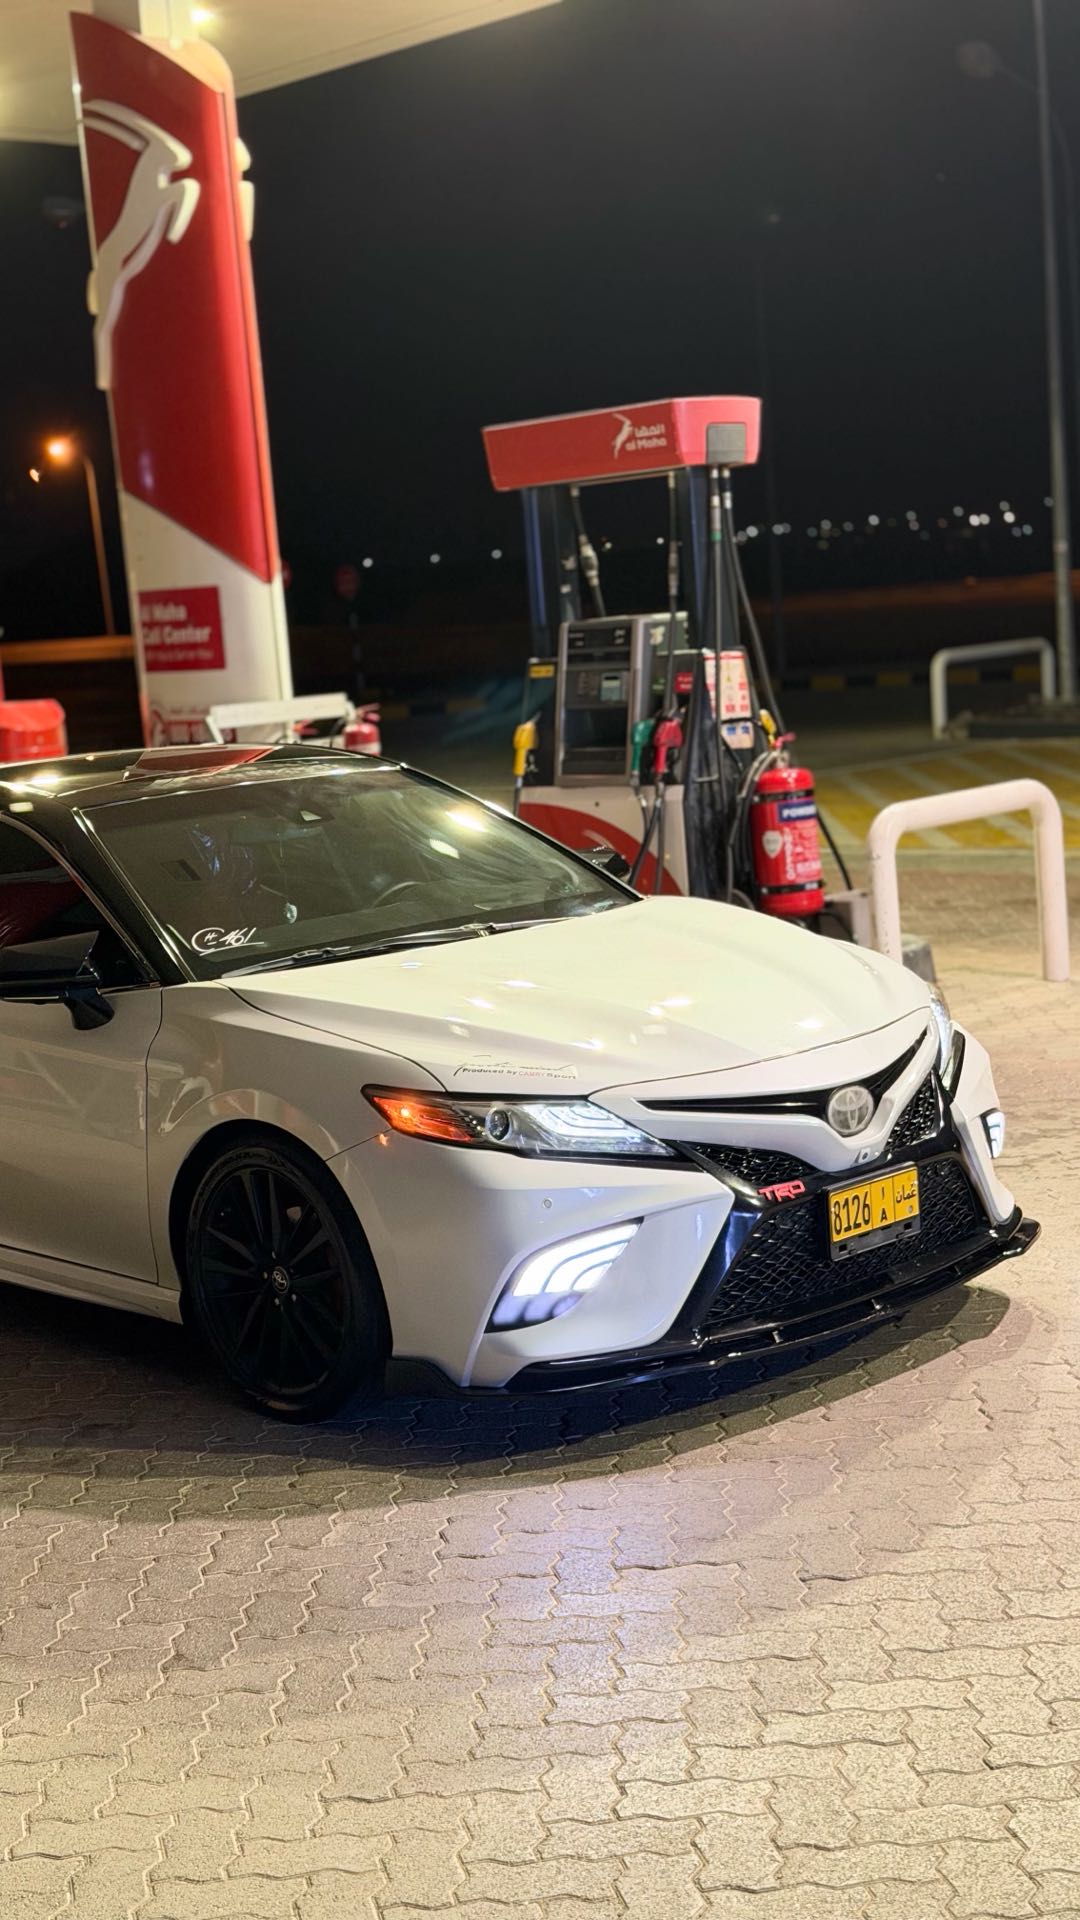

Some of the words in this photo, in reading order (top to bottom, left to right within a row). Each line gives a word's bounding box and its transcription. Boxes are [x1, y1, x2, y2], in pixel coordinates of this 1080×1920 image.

[163, 625, 211, 645] Center
[462, 1066, 505, 1075] Produced
[758, 1180, 806, 1202] TRD
[833, 1191, 871, 1236] 8126
[880, 1208, 888, 1222] A
